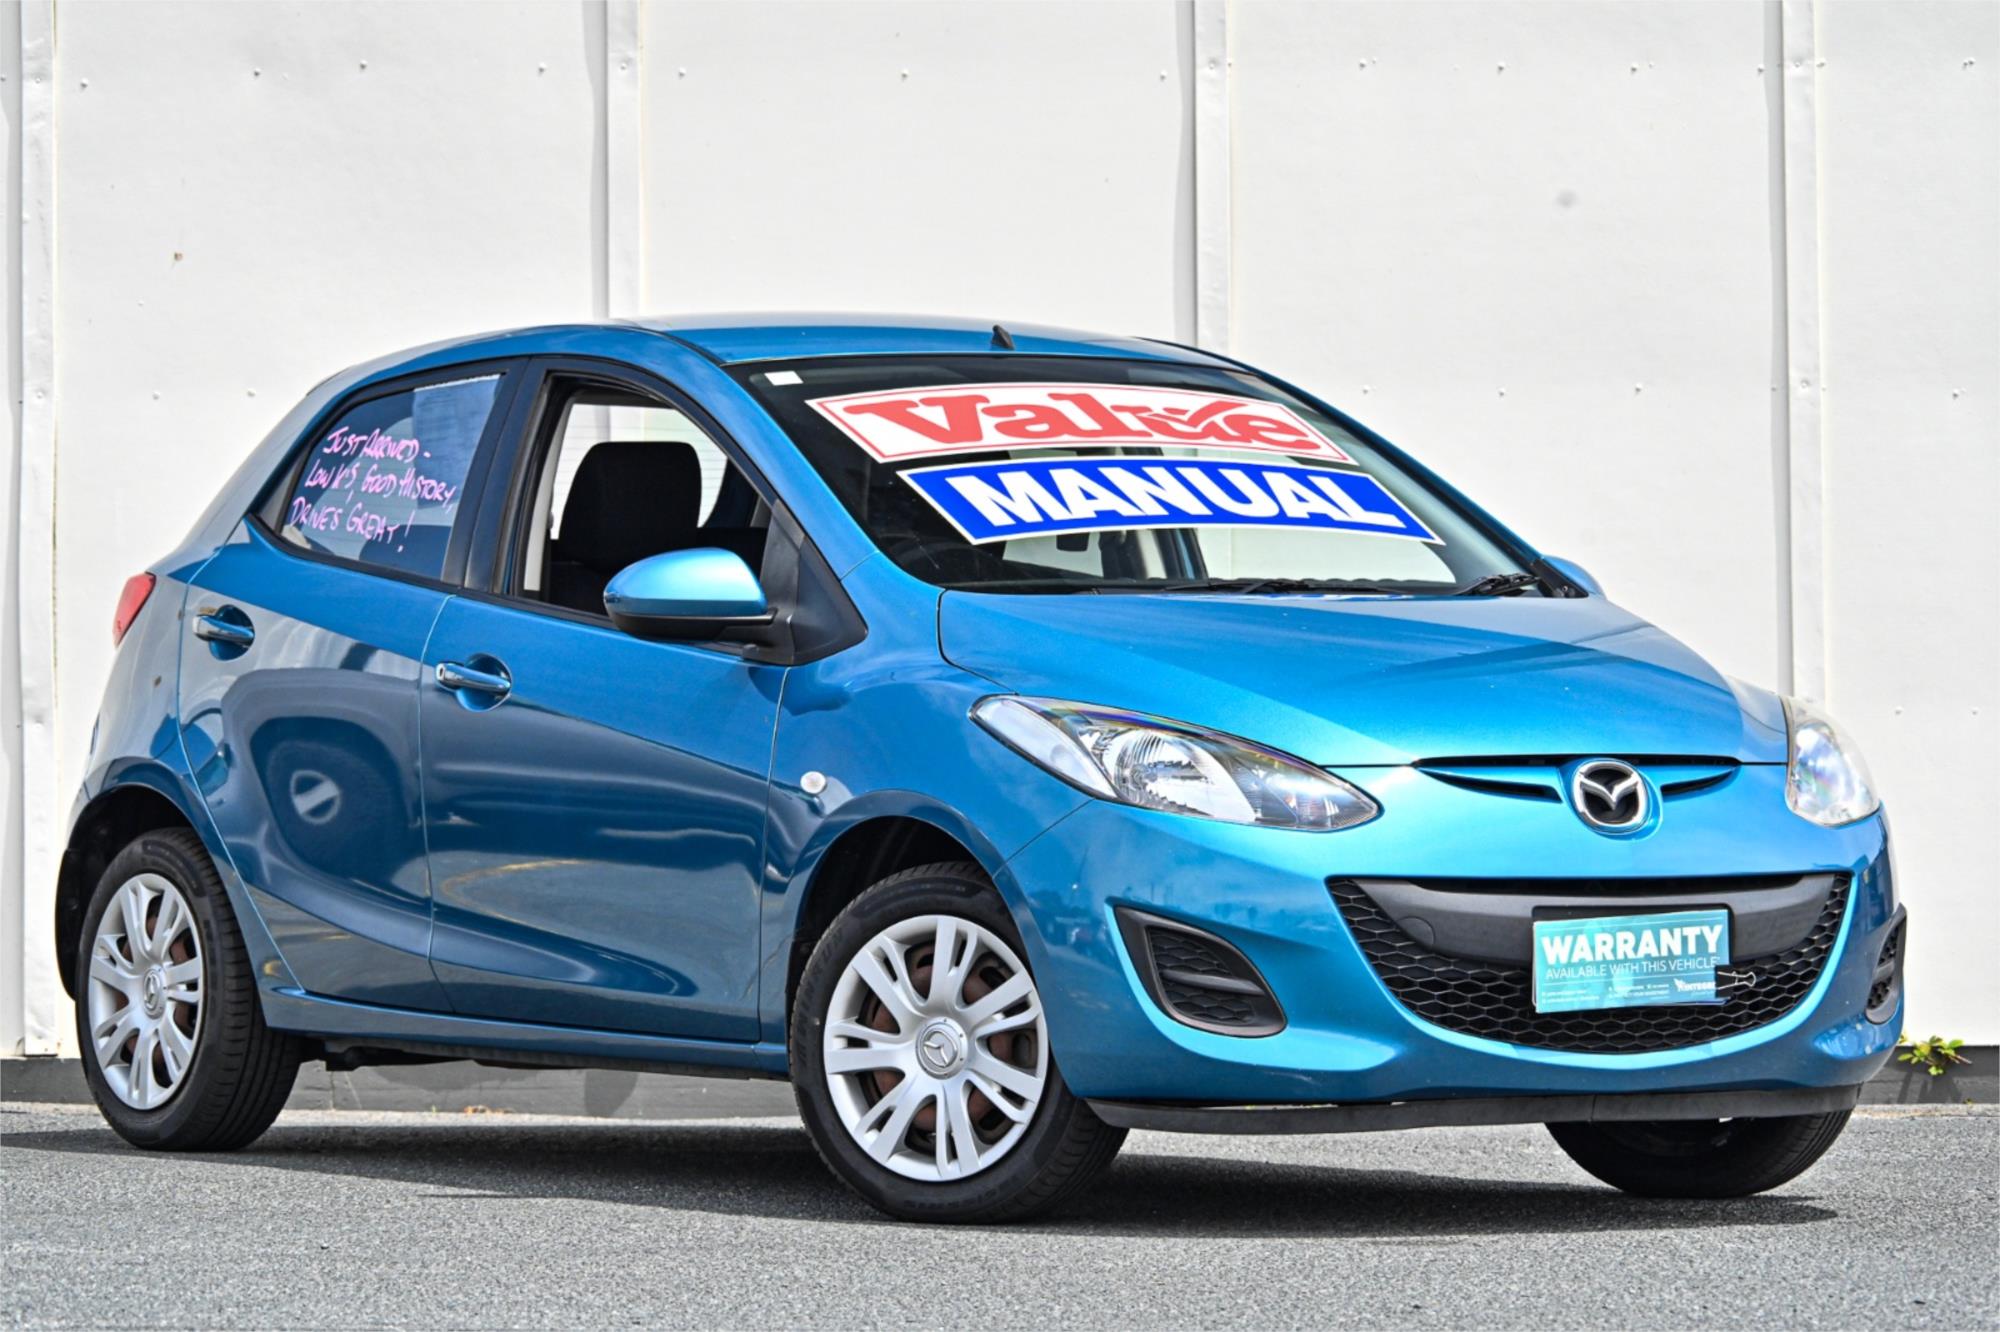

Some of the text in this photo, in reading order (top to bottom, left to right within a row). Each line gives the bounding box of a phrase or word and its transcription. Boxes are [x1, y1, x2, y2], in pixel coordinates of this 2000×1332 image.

[323, 426, 367, 456] JUST
[843, 392, 1322, 451] Value
[945, 466, 1407, 529] MANUAL
[1541, 924, 1723, 965] WARRANTY
[1545, 964, 1607, 980] AVAILABLE
[1608, 961, 1639, 977] WITH
[1641, 959, 1667, 973] THIS
